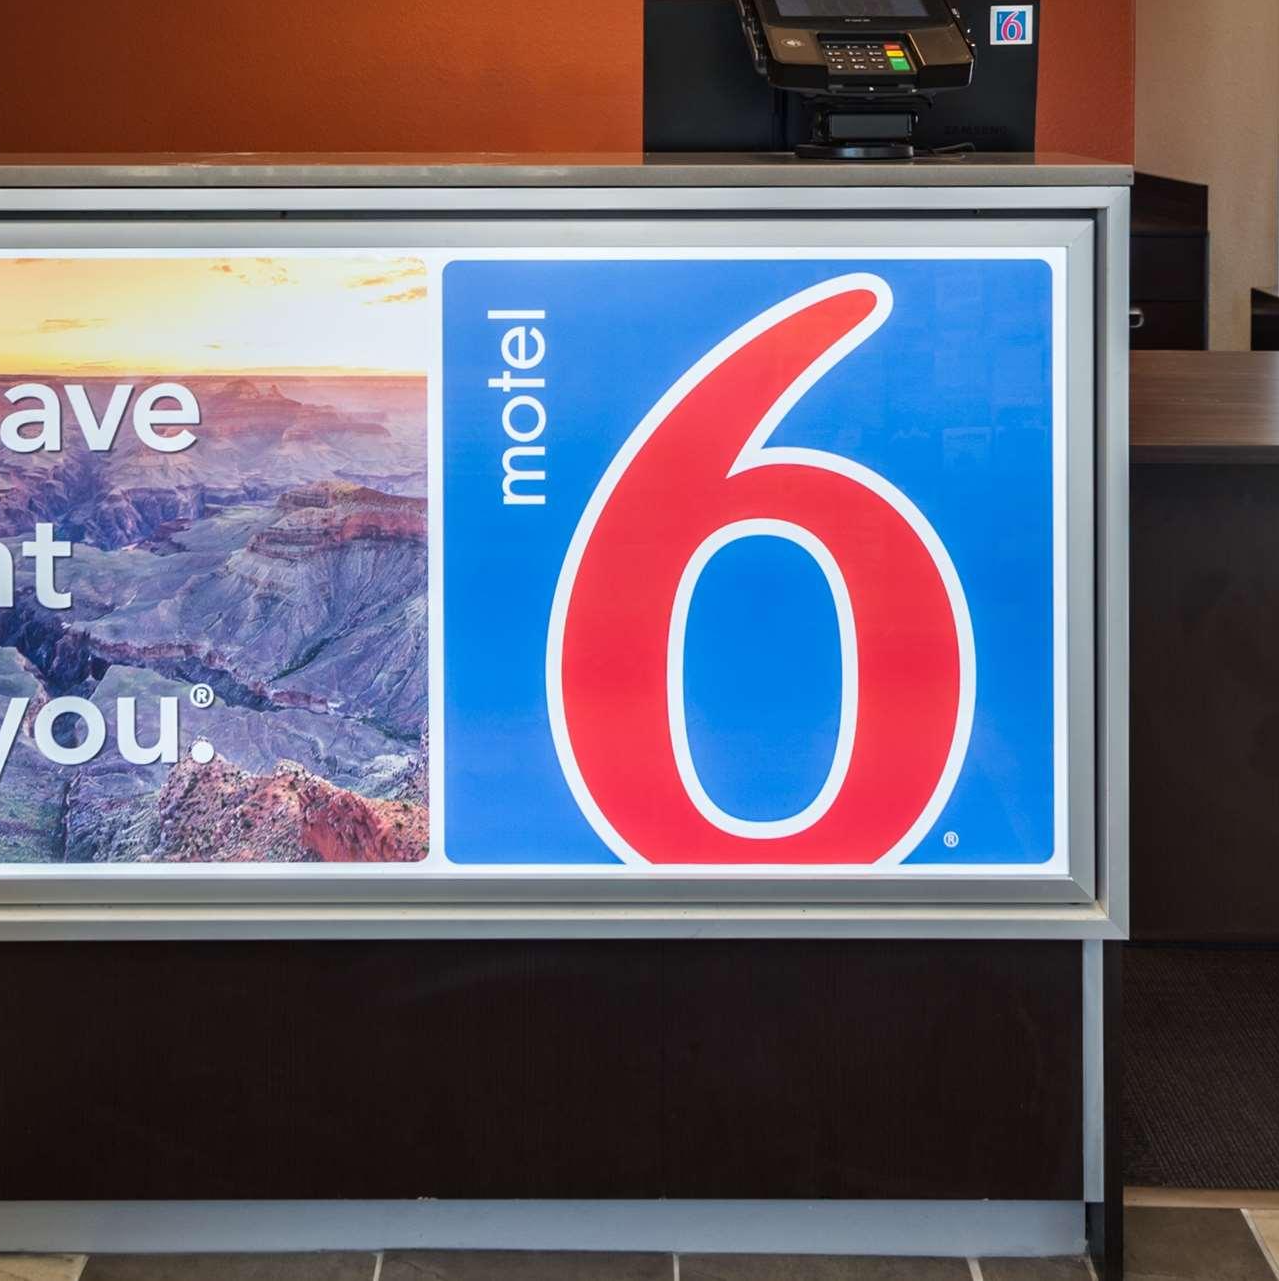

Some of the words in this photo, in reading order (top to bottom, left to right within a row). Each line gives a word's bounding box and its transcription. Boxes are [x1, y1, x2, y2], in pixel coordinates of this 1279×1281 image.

[1001, 9, 1023, 42] 6
[488, 309, 546, 505] motel
[546, 272, 977, 865] 6
